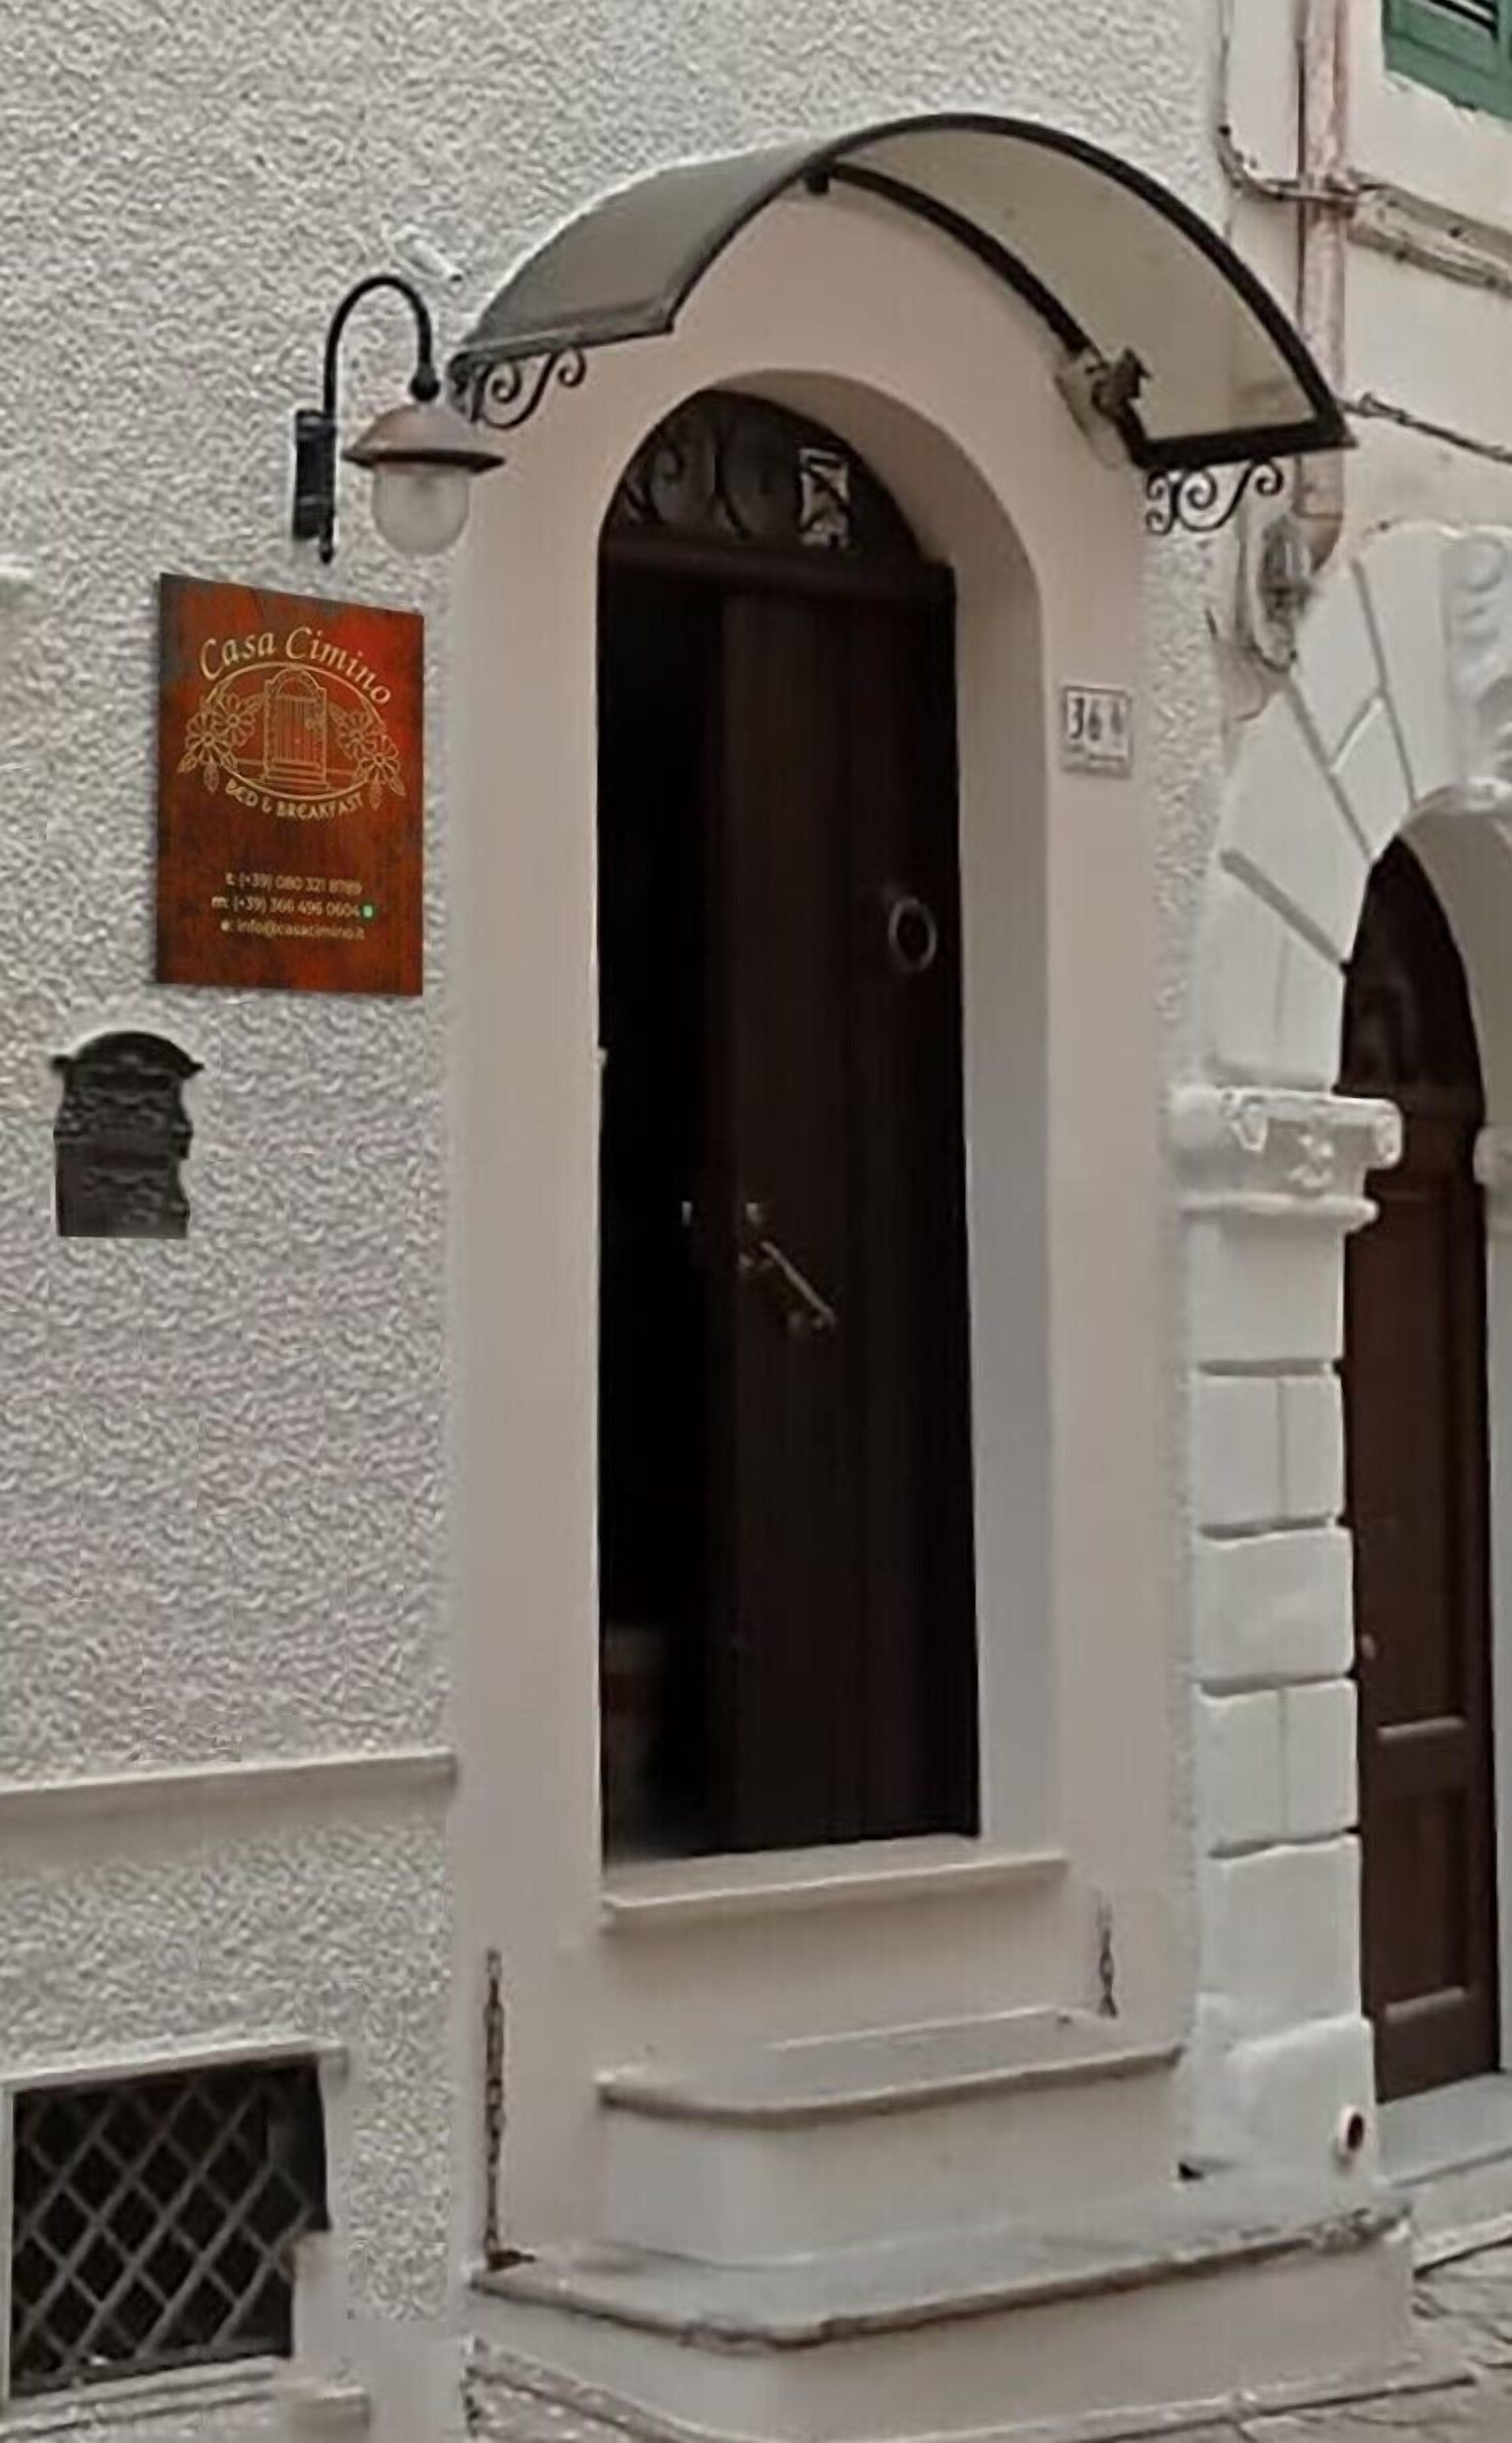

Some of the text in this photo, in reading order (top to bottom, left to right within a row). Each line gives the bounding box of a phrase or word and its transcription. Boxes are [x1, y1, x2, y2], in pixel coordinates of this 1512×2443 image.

[200, 626, 392, 704] Casa Cimino
[225, 779, 259, 807] BED
[277, 790, 363, 820] BREAKFAST
[239, 872, 273, 893] (+39)
[233, 895, 268, 915] (+39)
